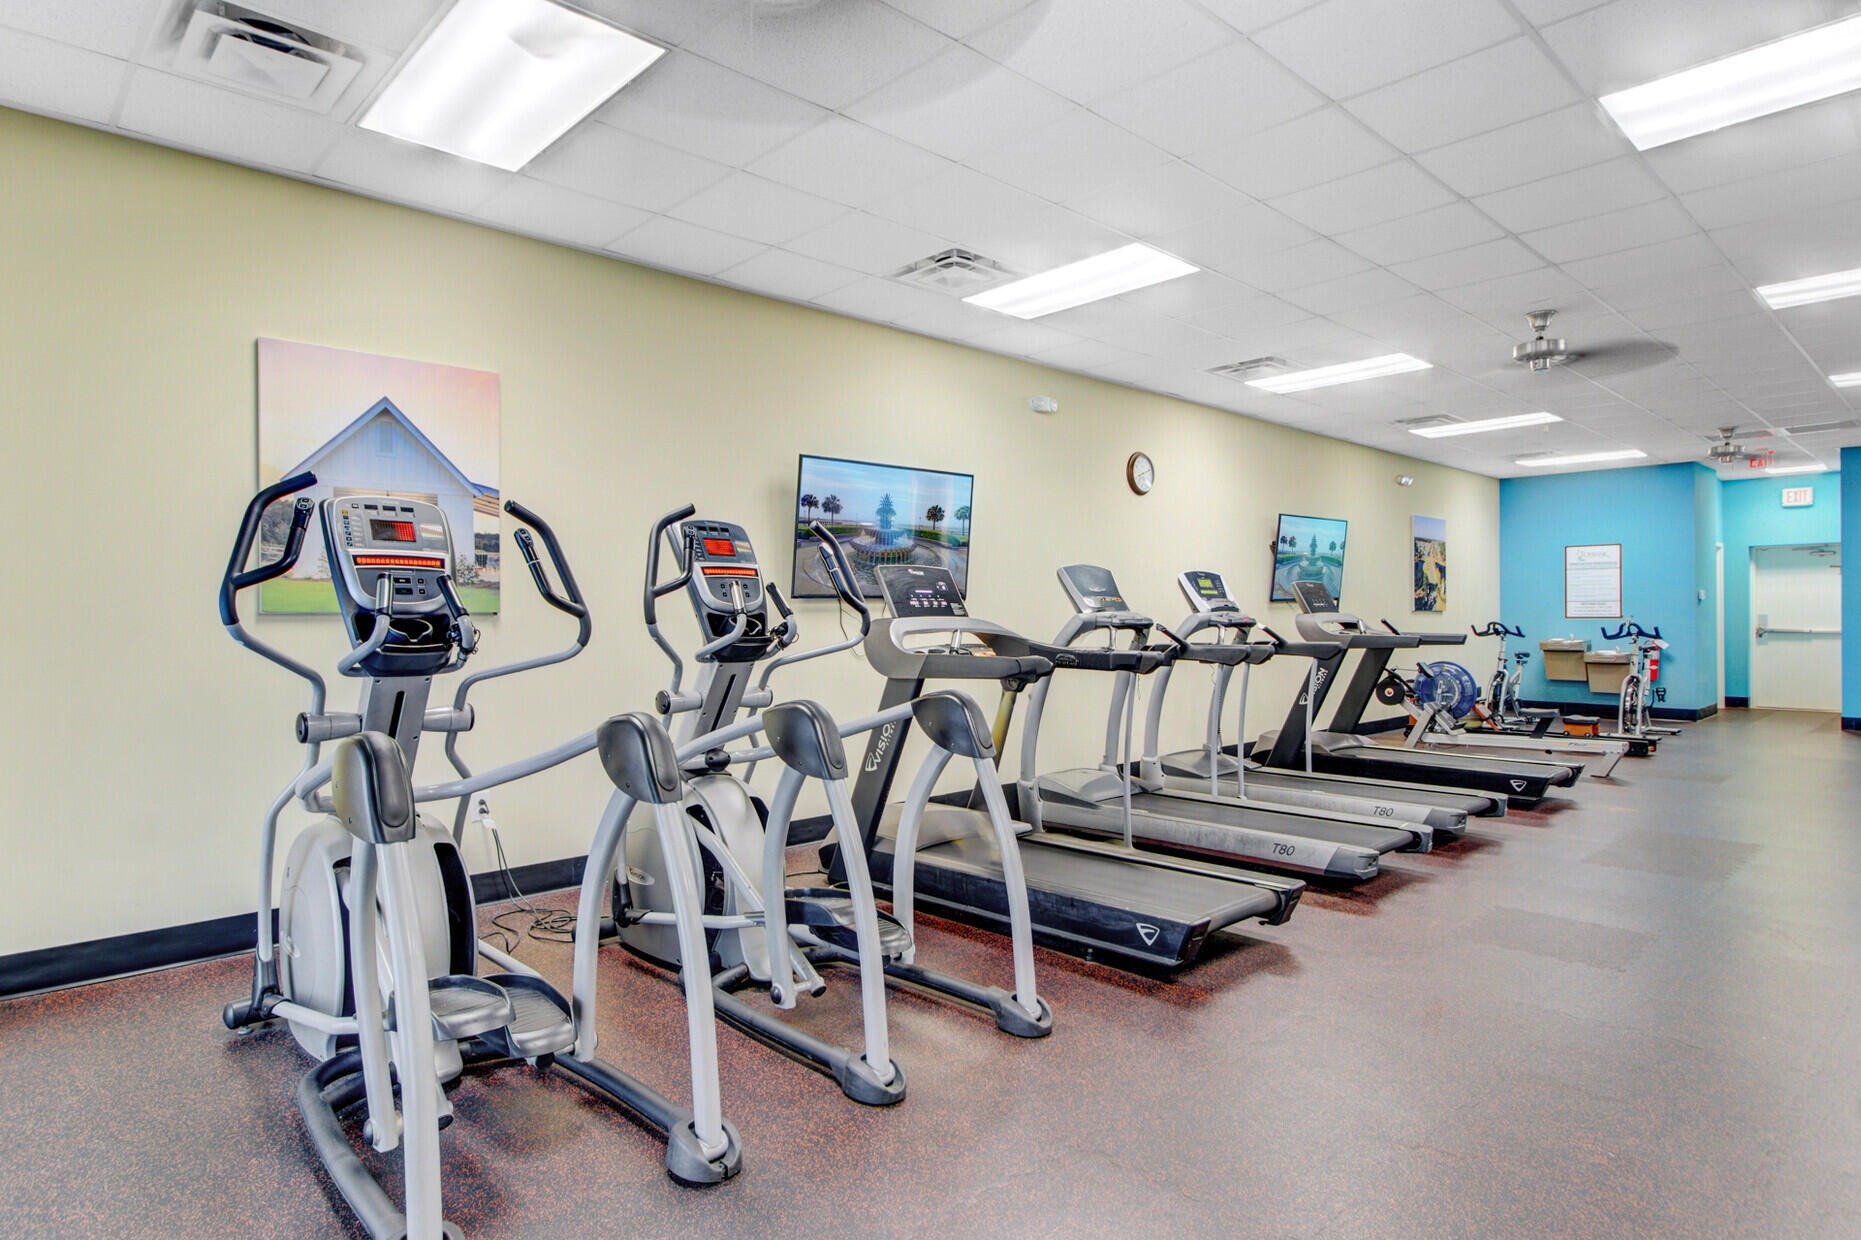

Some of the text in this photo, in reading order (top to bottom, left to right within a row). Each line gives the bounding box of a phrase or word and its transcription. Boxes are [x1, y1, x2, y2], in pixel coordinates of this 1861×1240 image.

[1786, 489, 1809, 504] EXIT
[874, 723, 891, 763] VISIO
[1373, 806, 1394, 817] T80
[1272, 842, 1296, 856] T80
